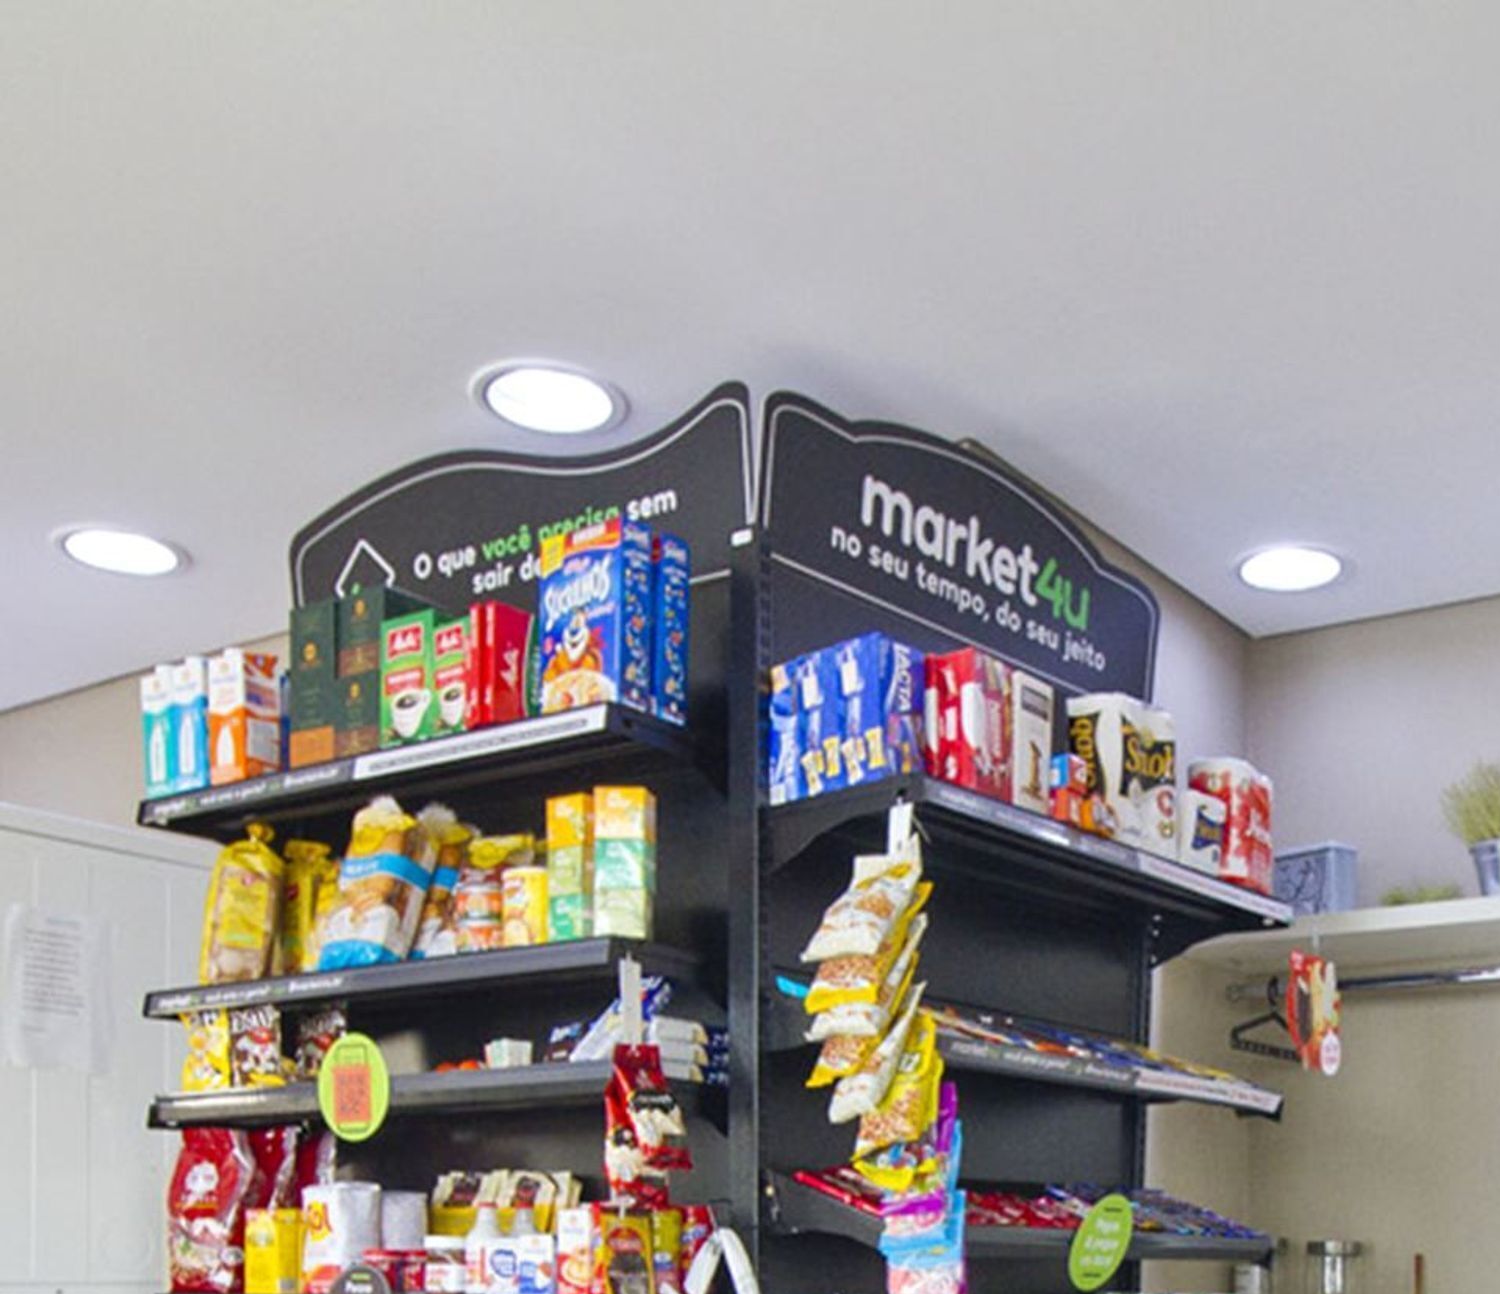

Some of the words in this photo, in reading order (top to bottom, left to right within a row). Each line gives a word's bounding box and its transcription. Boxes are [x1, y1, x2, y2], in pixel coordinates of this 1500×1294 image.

[413, 553, 432, 579] O
[437, 546, 476, 577] que
[481, 524, 532, 561] você
[627, 490, 678, 521] sem
[472, 561, 514, 594] sair
[831, 526, 861, 558] no
[868, 544, 909, 579] seu
[915, 562, 989, 622] tempo,
[995, 600, 1022, 631] do
[1026, 620, 1059, 649] seu
[1063, 630, 1106, 672] jeito
